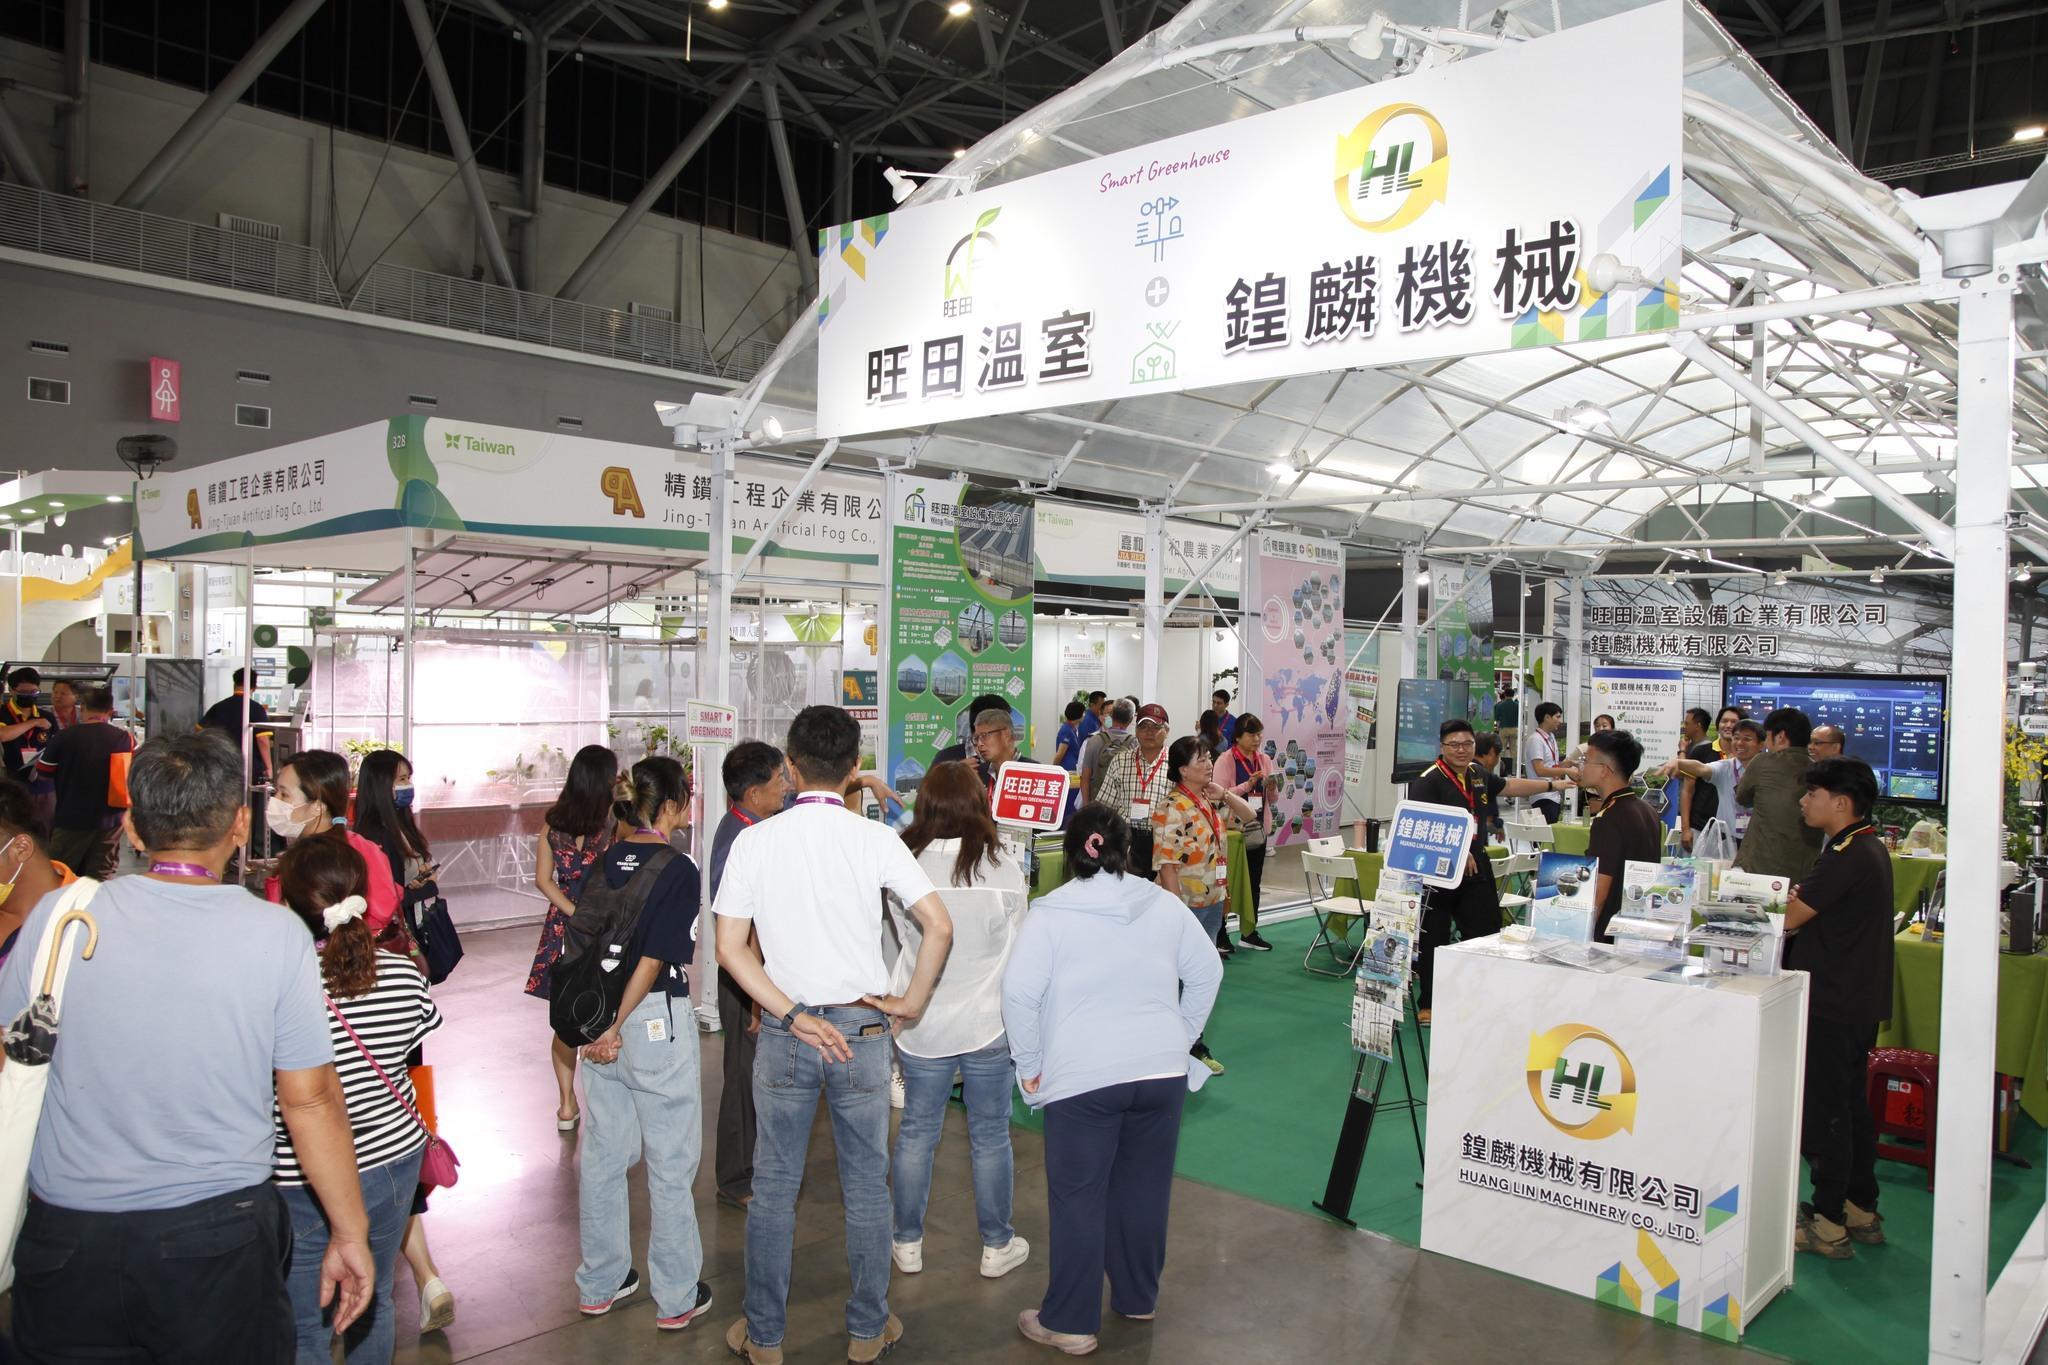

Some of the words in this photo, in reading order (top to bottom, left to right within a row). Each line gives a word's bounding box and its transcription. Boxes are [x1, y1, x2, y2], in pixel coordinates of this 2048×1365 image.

[1100, 165, 1145, 193] Smart
[1148, 146, 1231, 184] Greenhouse
[1223, 219, 1578, 352] 鍠麟機械
[943, 296, 973, 318] 旺田
[867, 308, 1093, 404] 旺田溫室
[392, 434, 406, 449] 328
[464, 436, 515, 456] Taiwan
[242, 506, 273, 523] Artificial
[275, 504, 289, 521] Fog
[1047, 513, 1073, 527] Taiwan
[822, 525, 845, 544] Fog
[851, 528, 876, 545] Co.,
[1130, 553, 1145, 561] HER
[1592, 604, 1886, 626] 旺田溫室設備企業有限公司
[1590, 634, 1779, 656] 鍠麟機械有限公司
[700, 711, 723, 722] SMART
[690, 726, 732, 738] GREENHOUSE
[1004, 777, 1061, 798] 旺田溫室
[1397, 816, 1463, 847] 鍠麟機械
[1548, 1057, 1612, 1111] HL
[1461, 1132, 1701, 1216] 鍠麟機械有限公司
[1459, 1168, 1509, 1191] HUANG
[1513, 1181, 1536, 1198] LIN
[1540, 1187, 1628, 1221] MACHINERY
[1631, 1212, 1664, 1234] CO.,
[1667, 1221, 1702, 1244] LTD.
